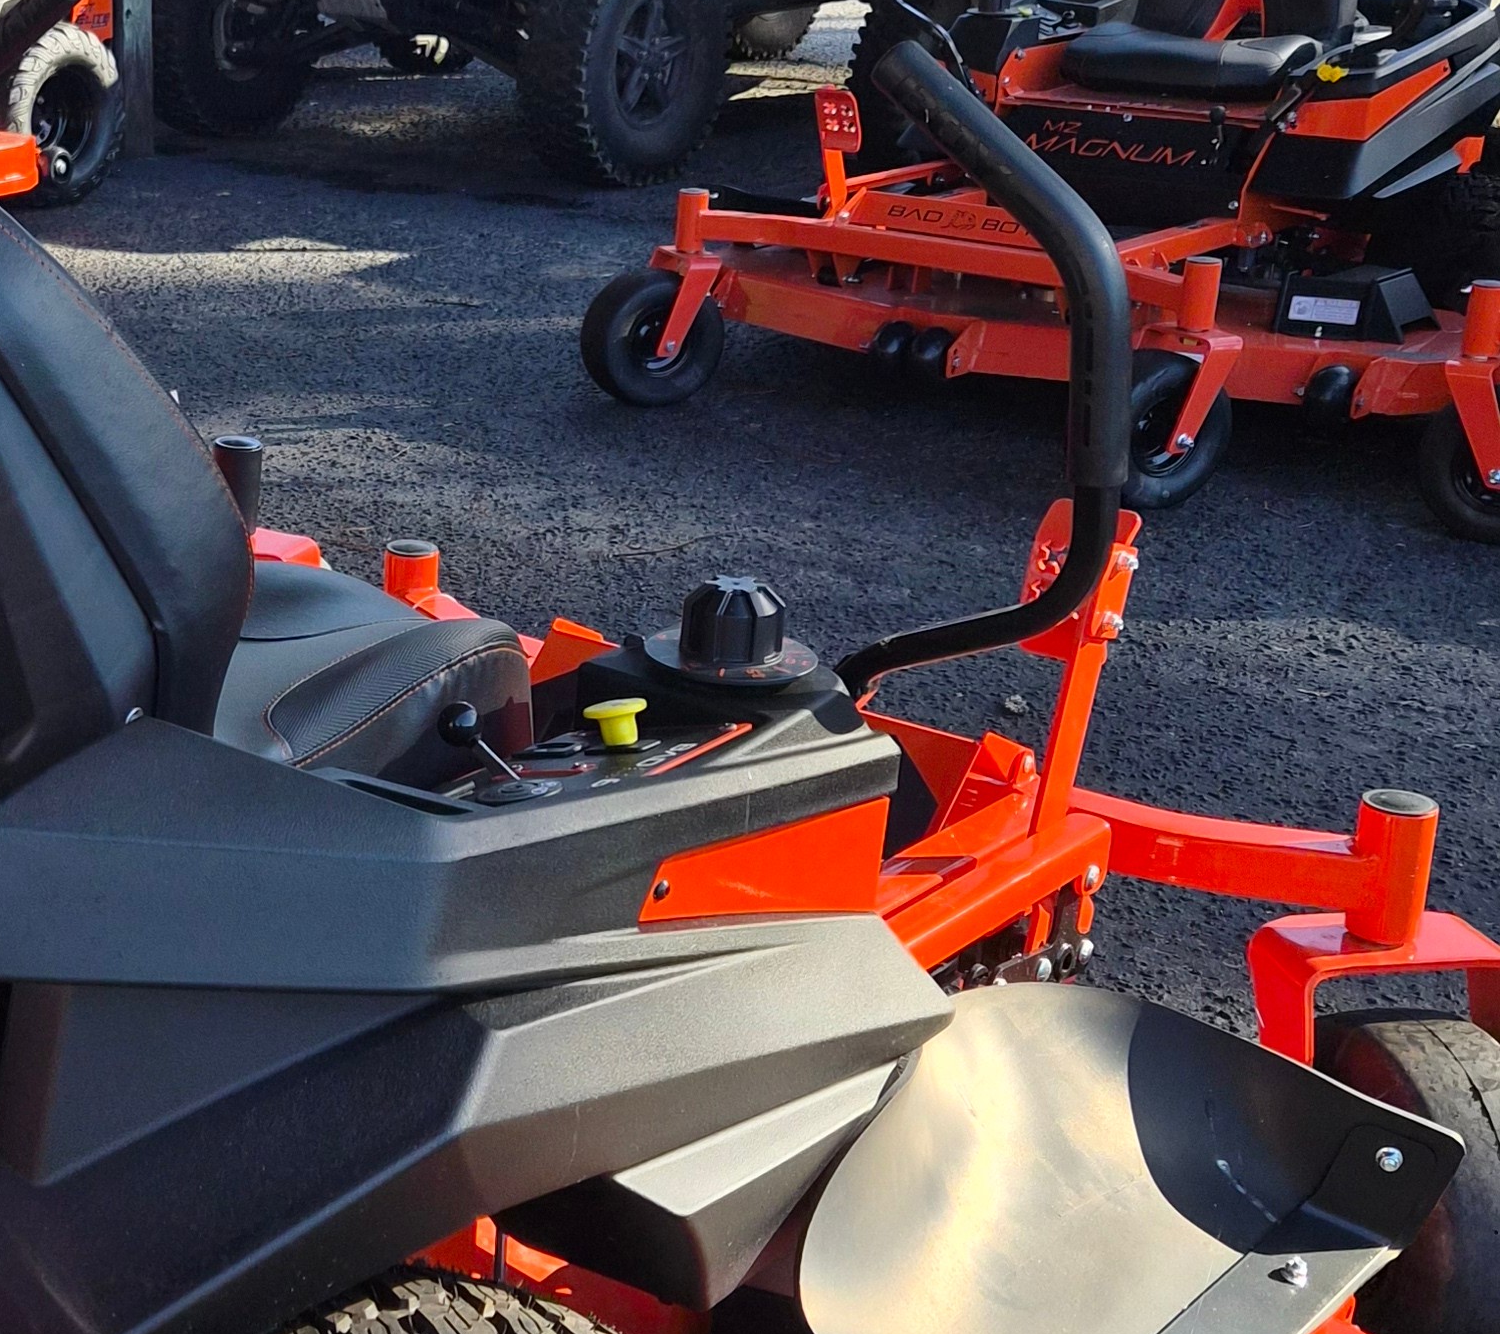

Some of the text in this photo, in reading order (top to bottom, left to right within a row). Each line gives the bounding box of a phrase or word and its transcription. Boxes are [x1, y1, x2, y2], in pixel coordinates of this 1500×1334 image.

[1042, 119, 1083, 134] MZ
[1024, 132, 1197, 166] MAGNUM
[887, 204, 1031, 236] BAD BO
